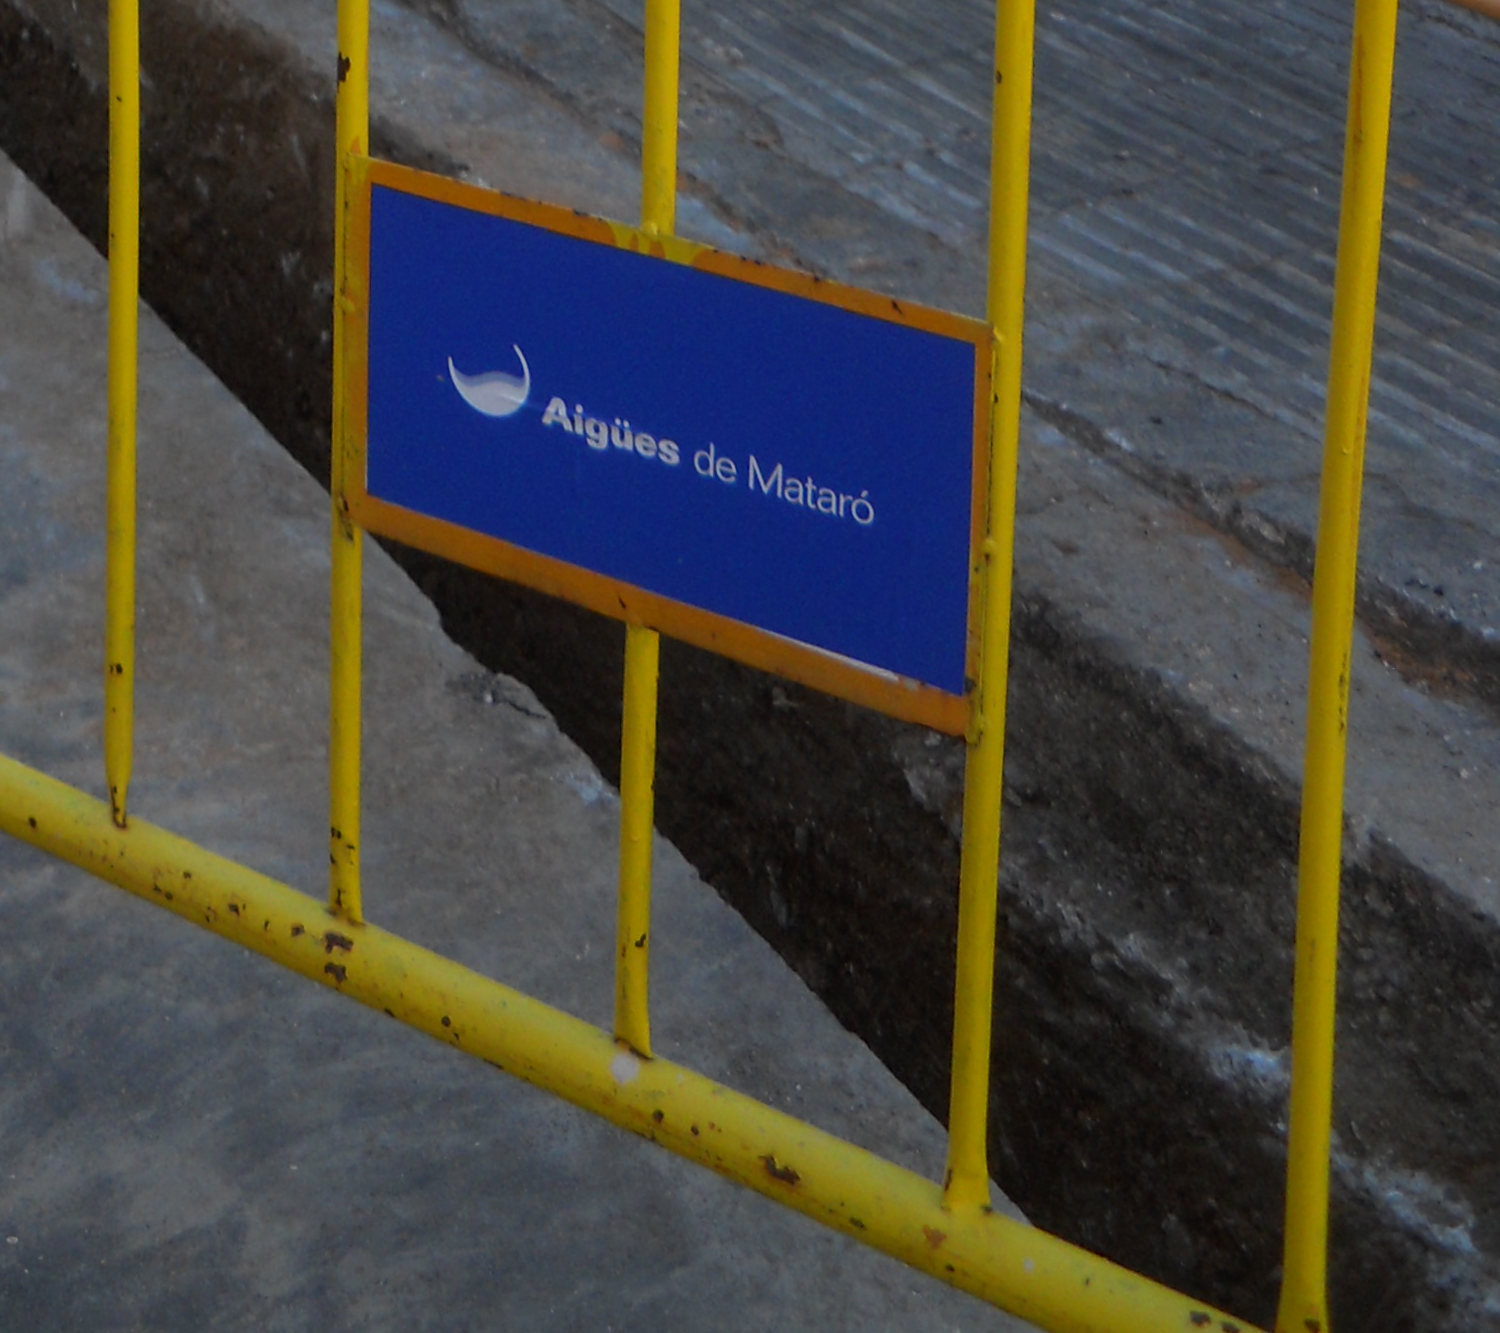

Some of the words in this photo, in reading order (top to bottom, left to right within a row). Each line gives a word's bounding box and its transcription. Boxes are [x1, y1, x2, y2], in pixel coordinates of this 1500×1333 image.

[542, 396, 681, 466] Aigües
[693, 442, 737, 483] de
[748, 454, 875, 525] Mataró
